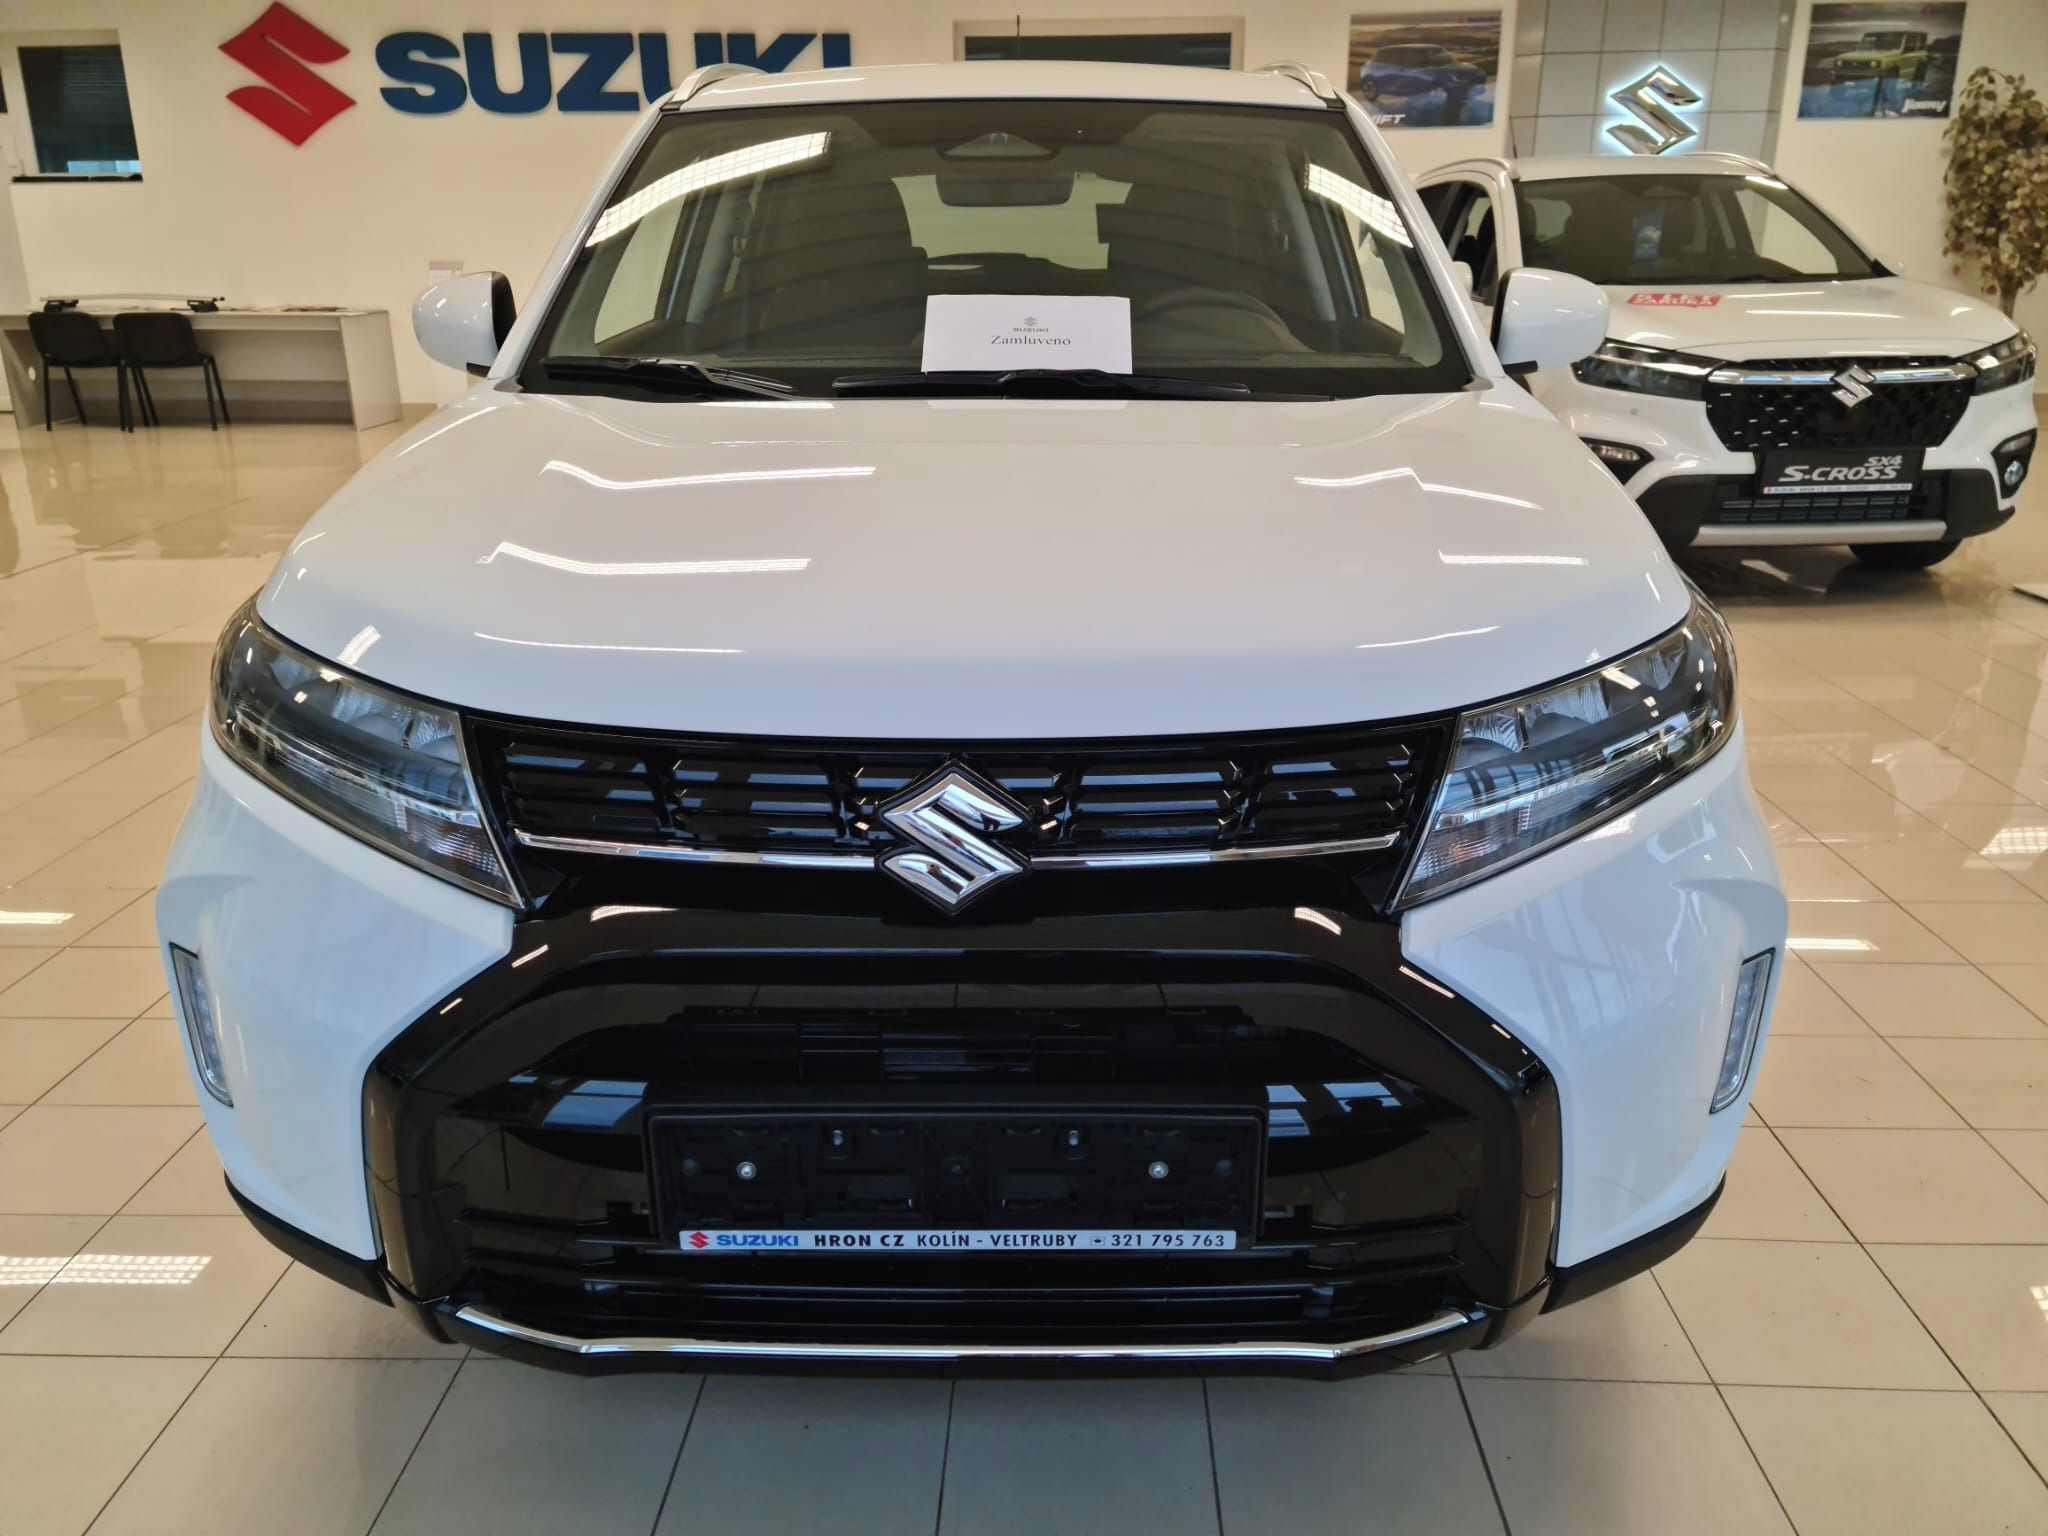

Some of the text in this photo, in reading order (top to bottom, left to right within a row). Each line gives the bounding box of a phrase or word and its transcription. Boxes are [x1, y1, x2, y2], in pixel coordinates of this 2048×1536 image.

[1371, 113, 1407, 126] IFT
[990, 335, 1072, 346] Zamluveno
[1863, 455, 1903, 467] SX4
[1778, 465, 1901, 482] S-CROSS
[716, 1234, 799, 1247] SUZUKI
[814, 1234, 872, 1247] HRON
[880, 1234, 905, 1247] CZ
[917, 1230, 970, 1247] KOLÍN
[990, 1234, 1078, 1247] VELTRUBY
[1111, 1233, 1143, 1247] 321
[1151, 1233, 1185, 1247] 795
[1192, 1233, 1226, 1247] 763
